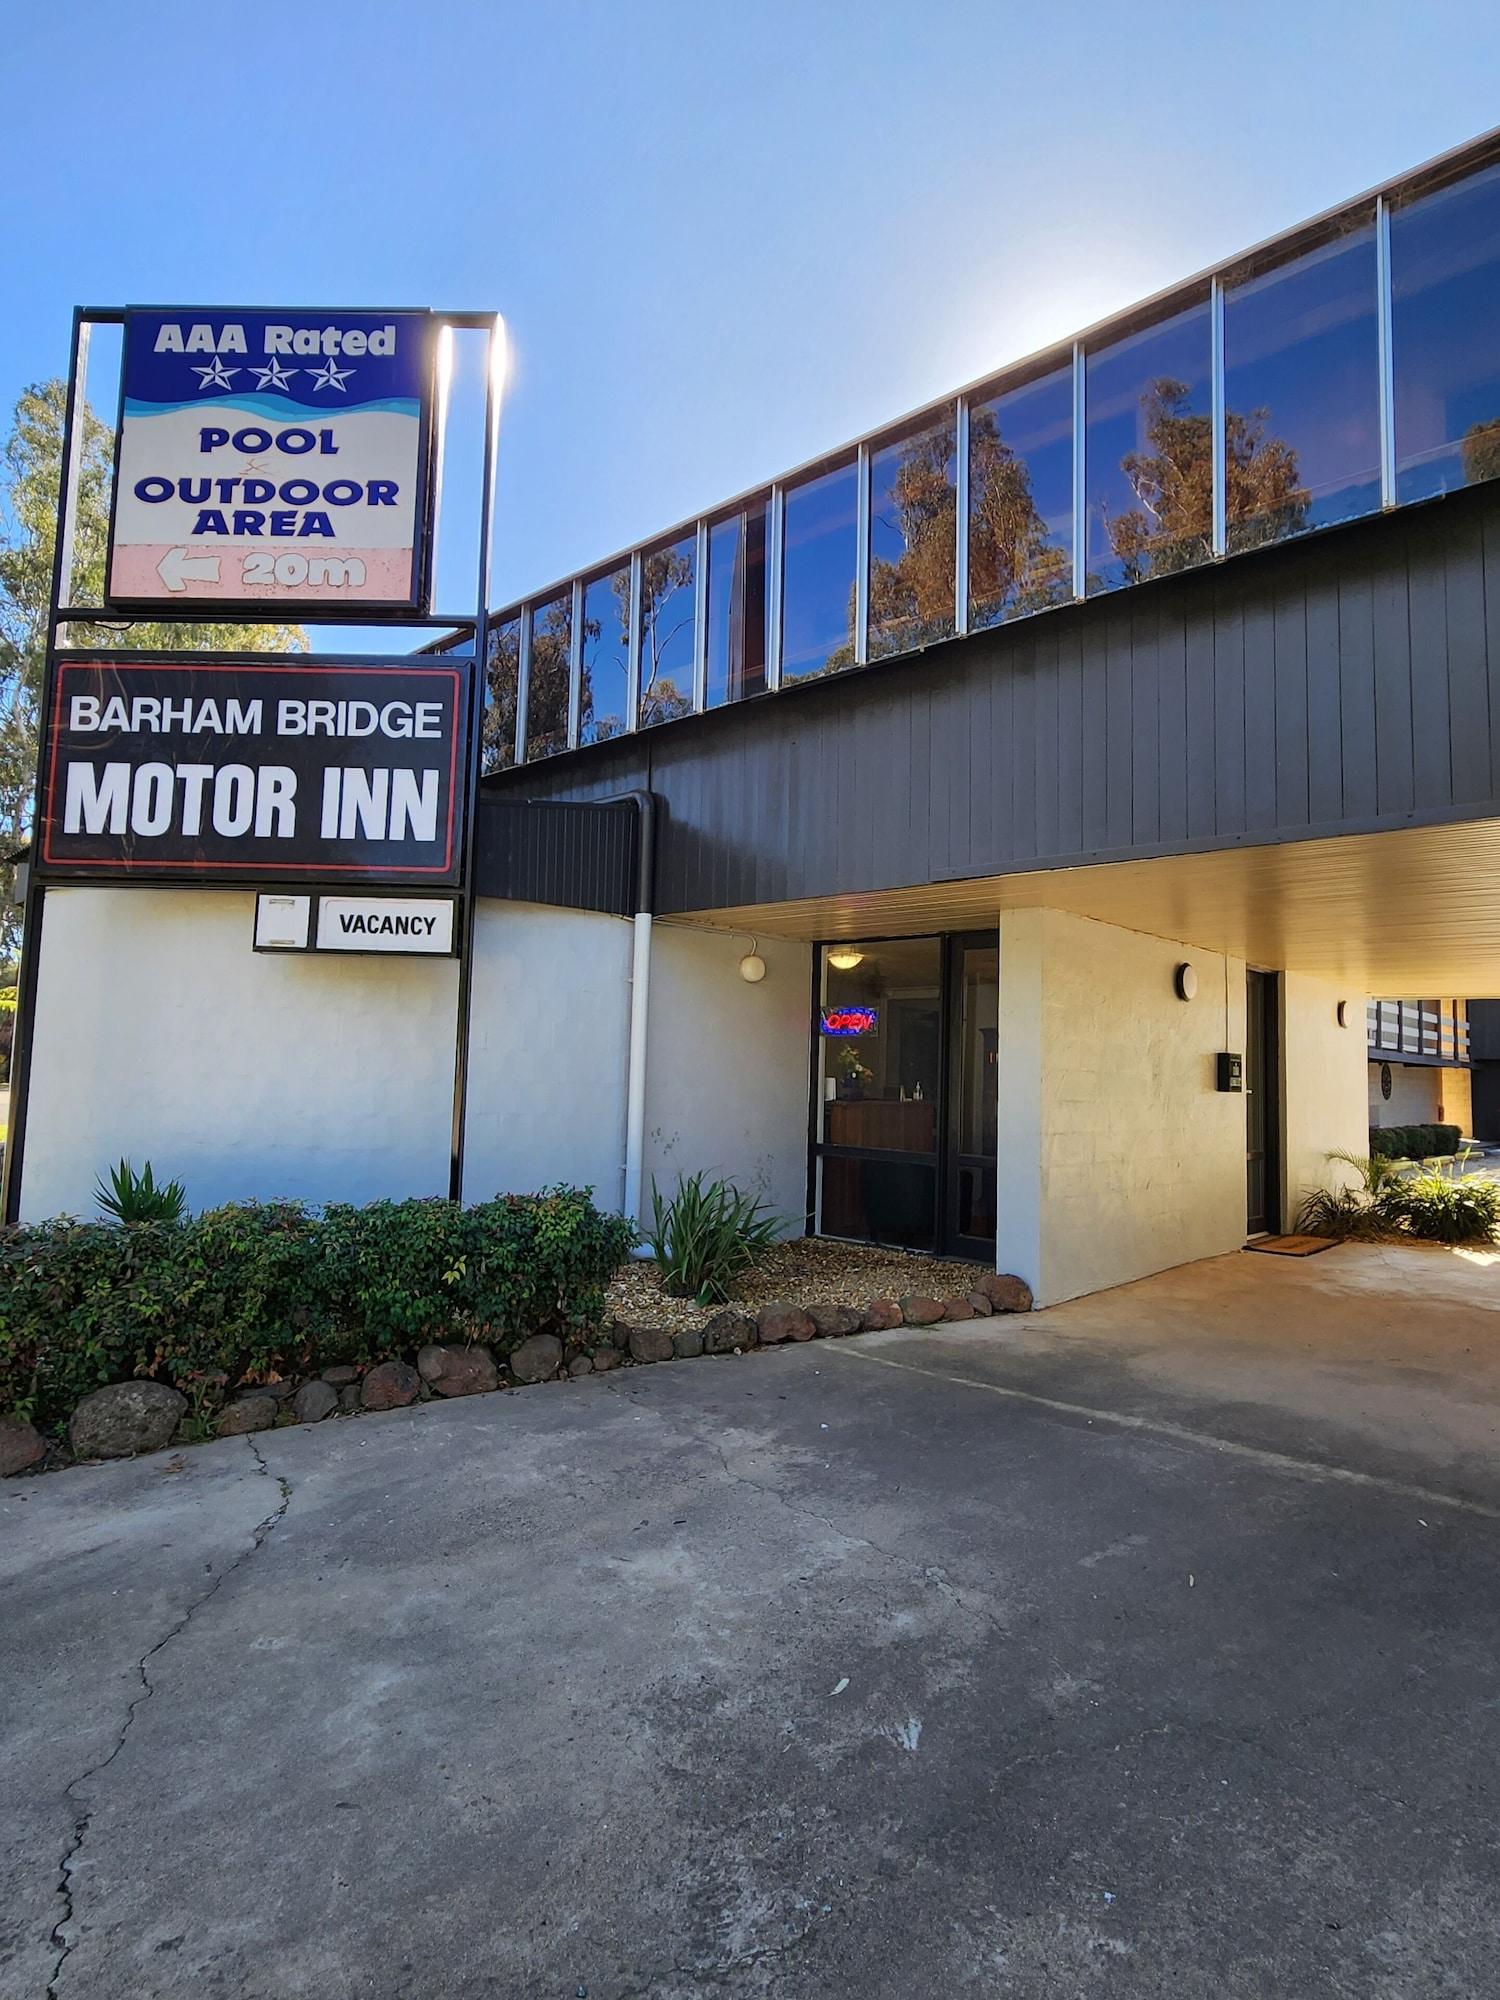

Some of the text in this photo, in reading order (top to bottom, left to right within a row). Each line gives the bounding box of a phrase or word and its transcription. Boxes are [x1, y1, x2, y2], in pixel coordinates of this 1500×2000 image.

[153, 324, 397, 356] AAA Rated
[199, 427, 340, 455] POOL
[134, 476, 400, 507] OUTDOOR
[191, 509, 336, 538] AREA
[241, 551, 368, 587] 20m
[69, 695, 443, 739] BARHAM BRIDGE
[63, 761, 440, 842] MOTOR INN
[339, 914, 437, 936] VACANCY
[827, 1013, 873, 1030] OPEN
